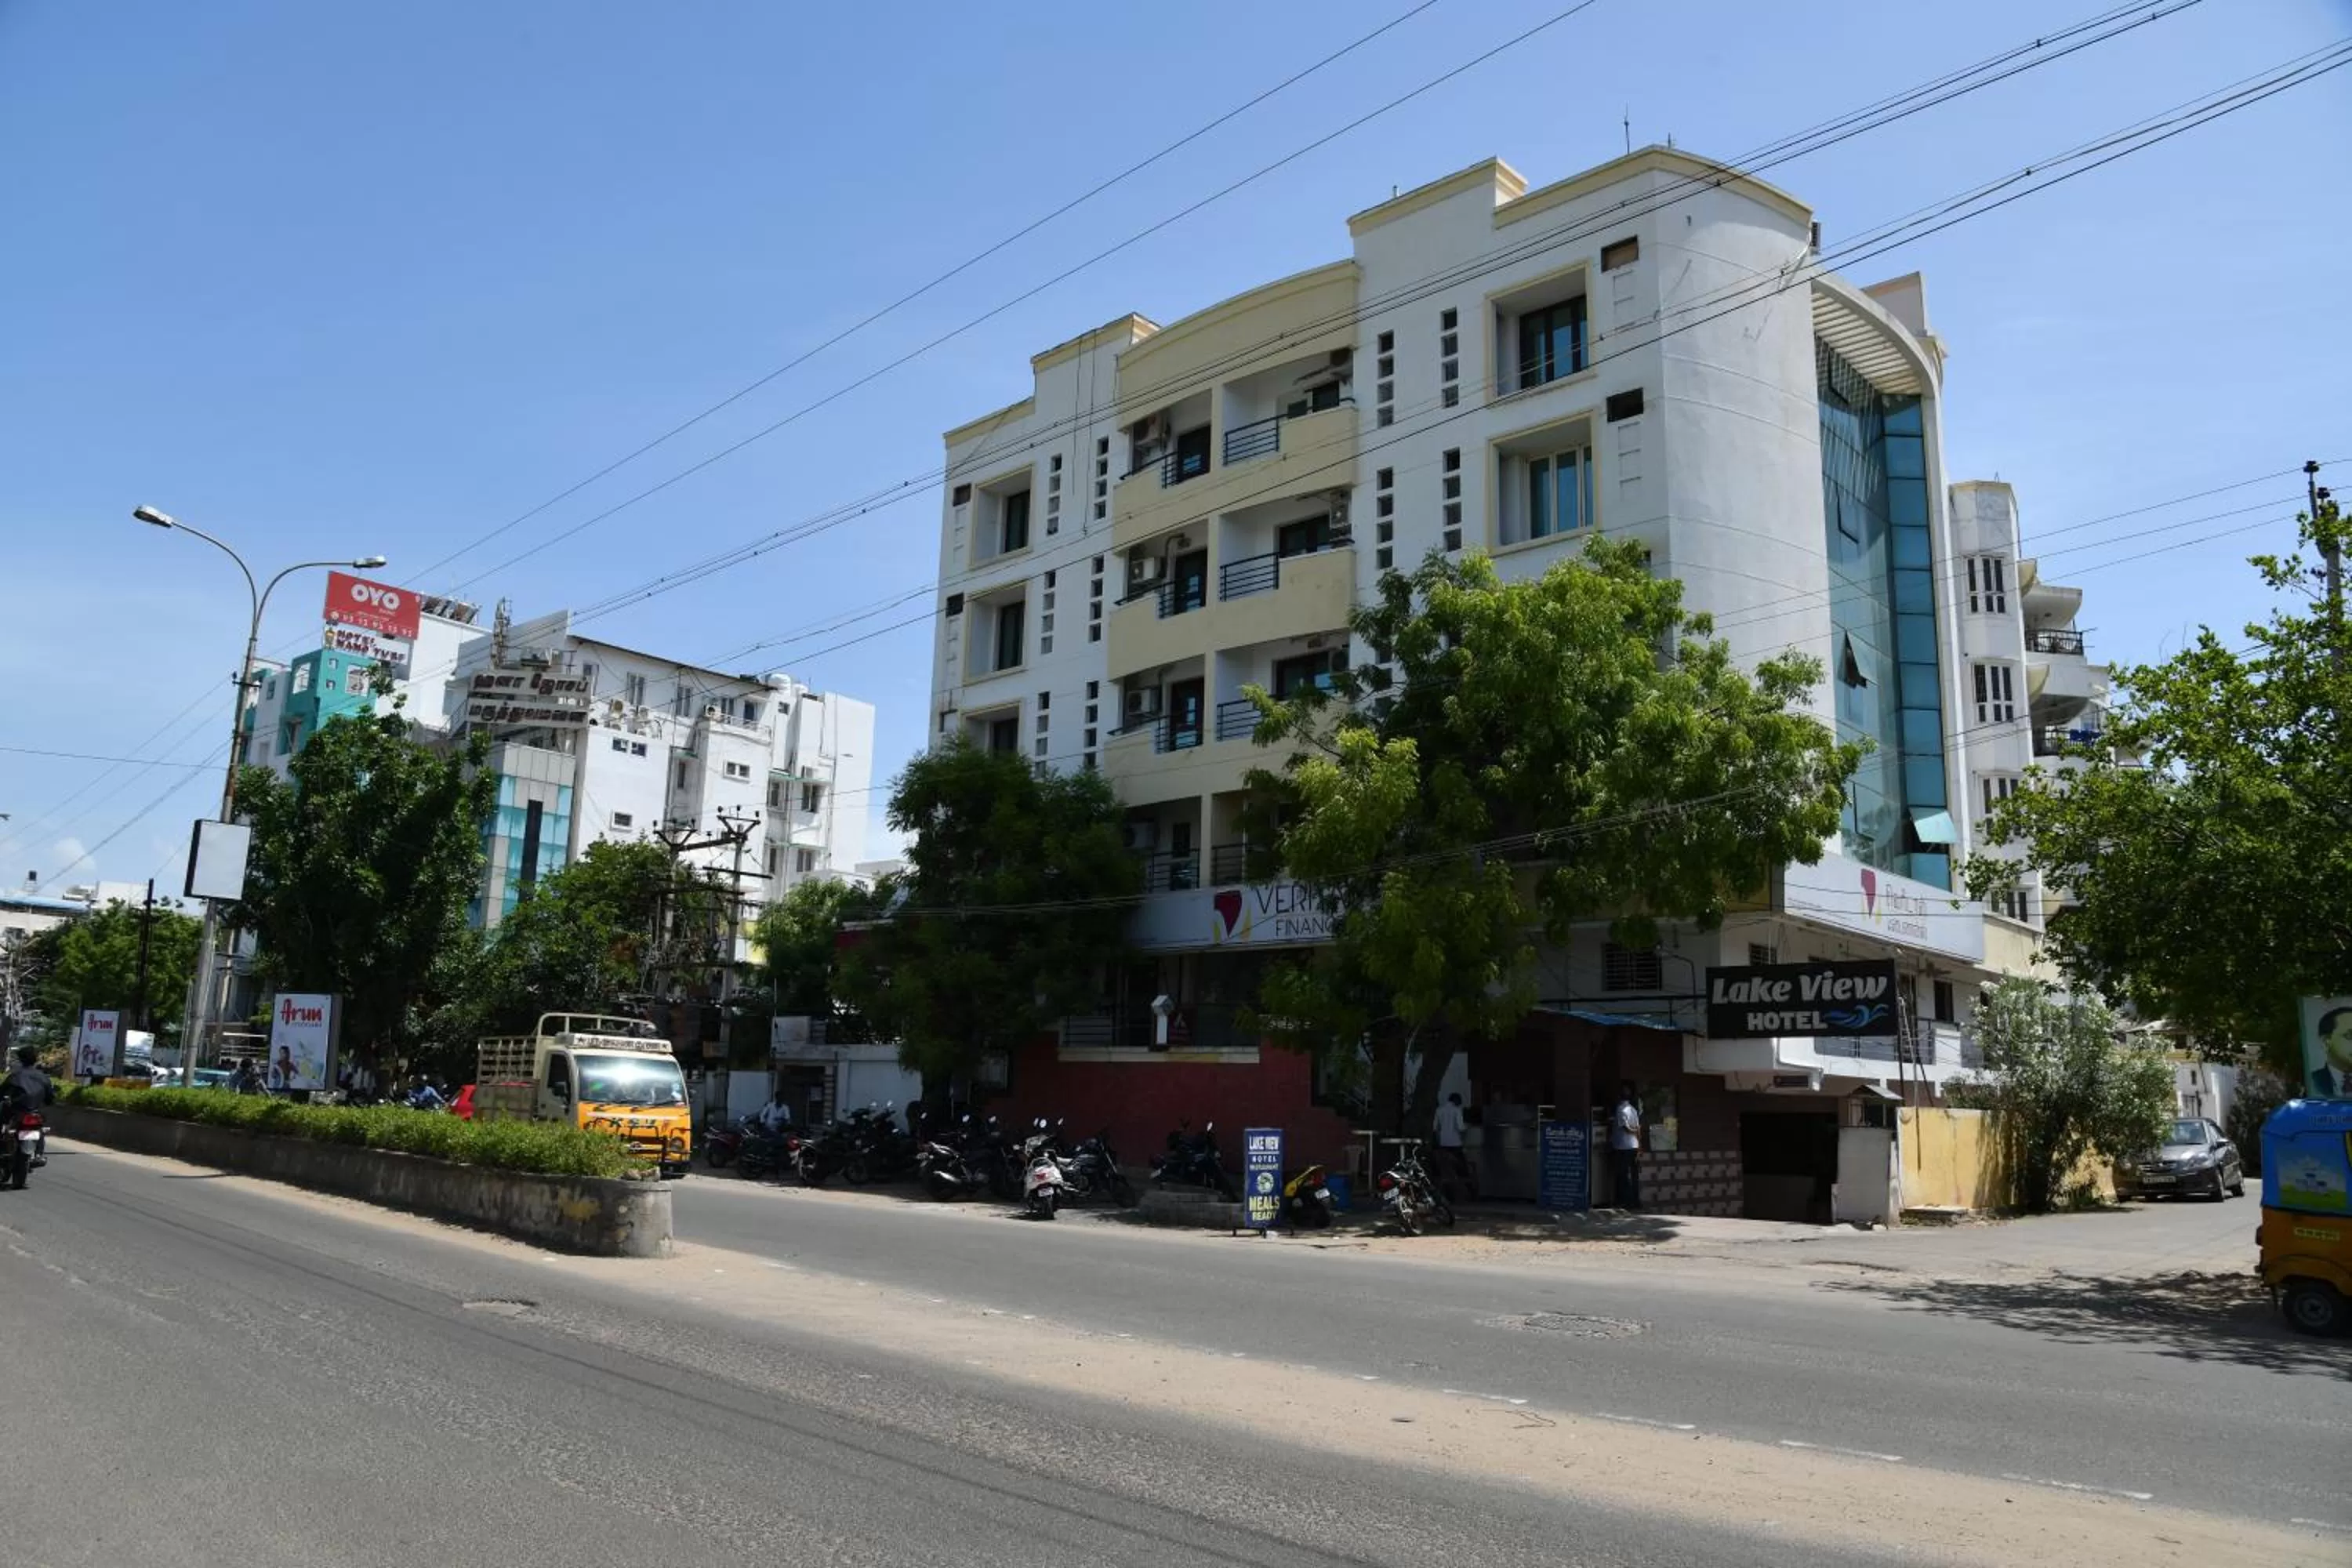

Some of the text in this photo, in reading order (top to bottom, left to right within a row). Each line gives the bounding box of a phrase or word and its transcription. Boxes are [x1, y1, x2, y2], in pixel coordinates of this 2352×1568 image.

[351, 583, 401, 610] OYO
[1276, 915, 1334, 936] FINANC
[1712, 971, 1888, 1004] Lake View
[1747, 1010, 1828, 1031] HOTEL
[1249, 1135, 1265, 1150] LAKE
[1249, 1196, 1279, 1211] MEALS
[1252, 1211, 1277, 1221] READY
